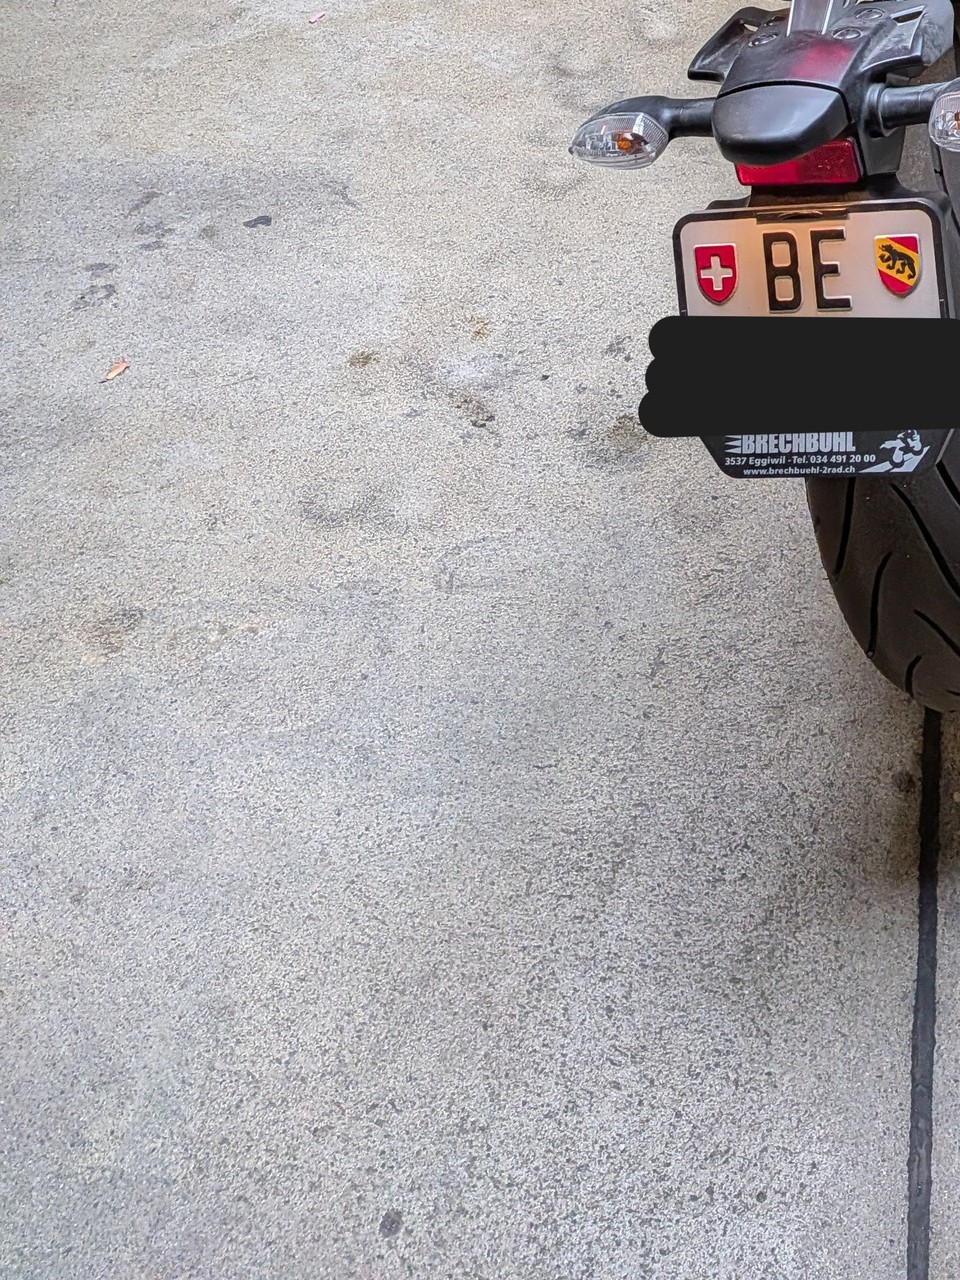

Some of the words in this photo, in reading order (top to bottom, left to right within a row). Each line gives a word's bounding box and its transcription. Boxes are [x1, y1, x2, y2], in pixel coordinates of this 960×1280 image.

[762, 227, 852, 313] BE
[724, 457, 747, 466] 3537
[749, 456, 786, 466] Eggiwil
[810, 455, 828, 464] 034
[829, 455, 847, 464] 491
[849, 455, 862, 463] 20
[863, 454, 876, 463] 00
[743, 466, 856, 475] www.brechbuehl-2rad.ch
